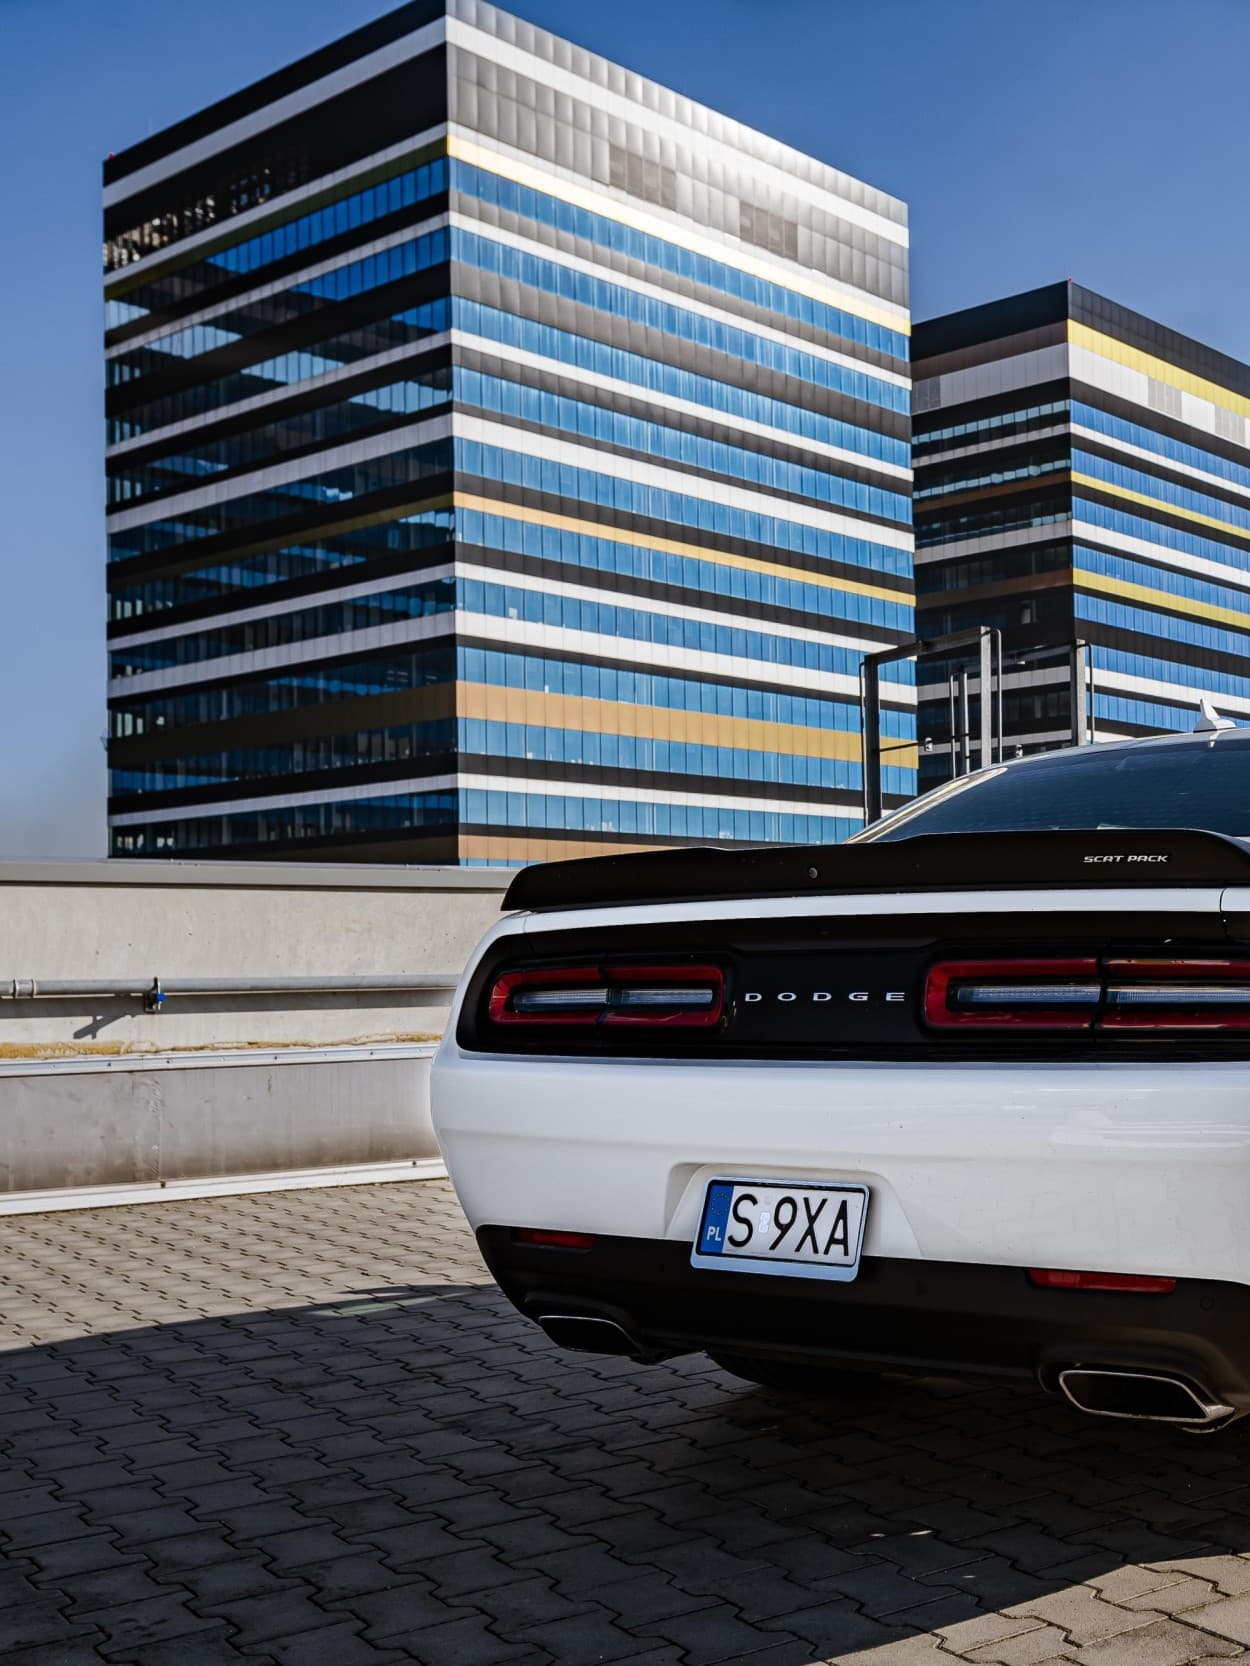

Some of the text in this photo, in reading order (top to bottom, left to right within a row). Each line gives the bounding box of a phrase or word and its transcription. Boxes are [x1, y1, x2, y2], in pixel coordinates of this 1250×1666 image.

[1083, 855, 1168, 863] SCAT PACK
[744, 992, 905, 1002] DODGE
[727, 1193, 850, 1257] S 9XA
[706, 1225, 722, 1241] PL
